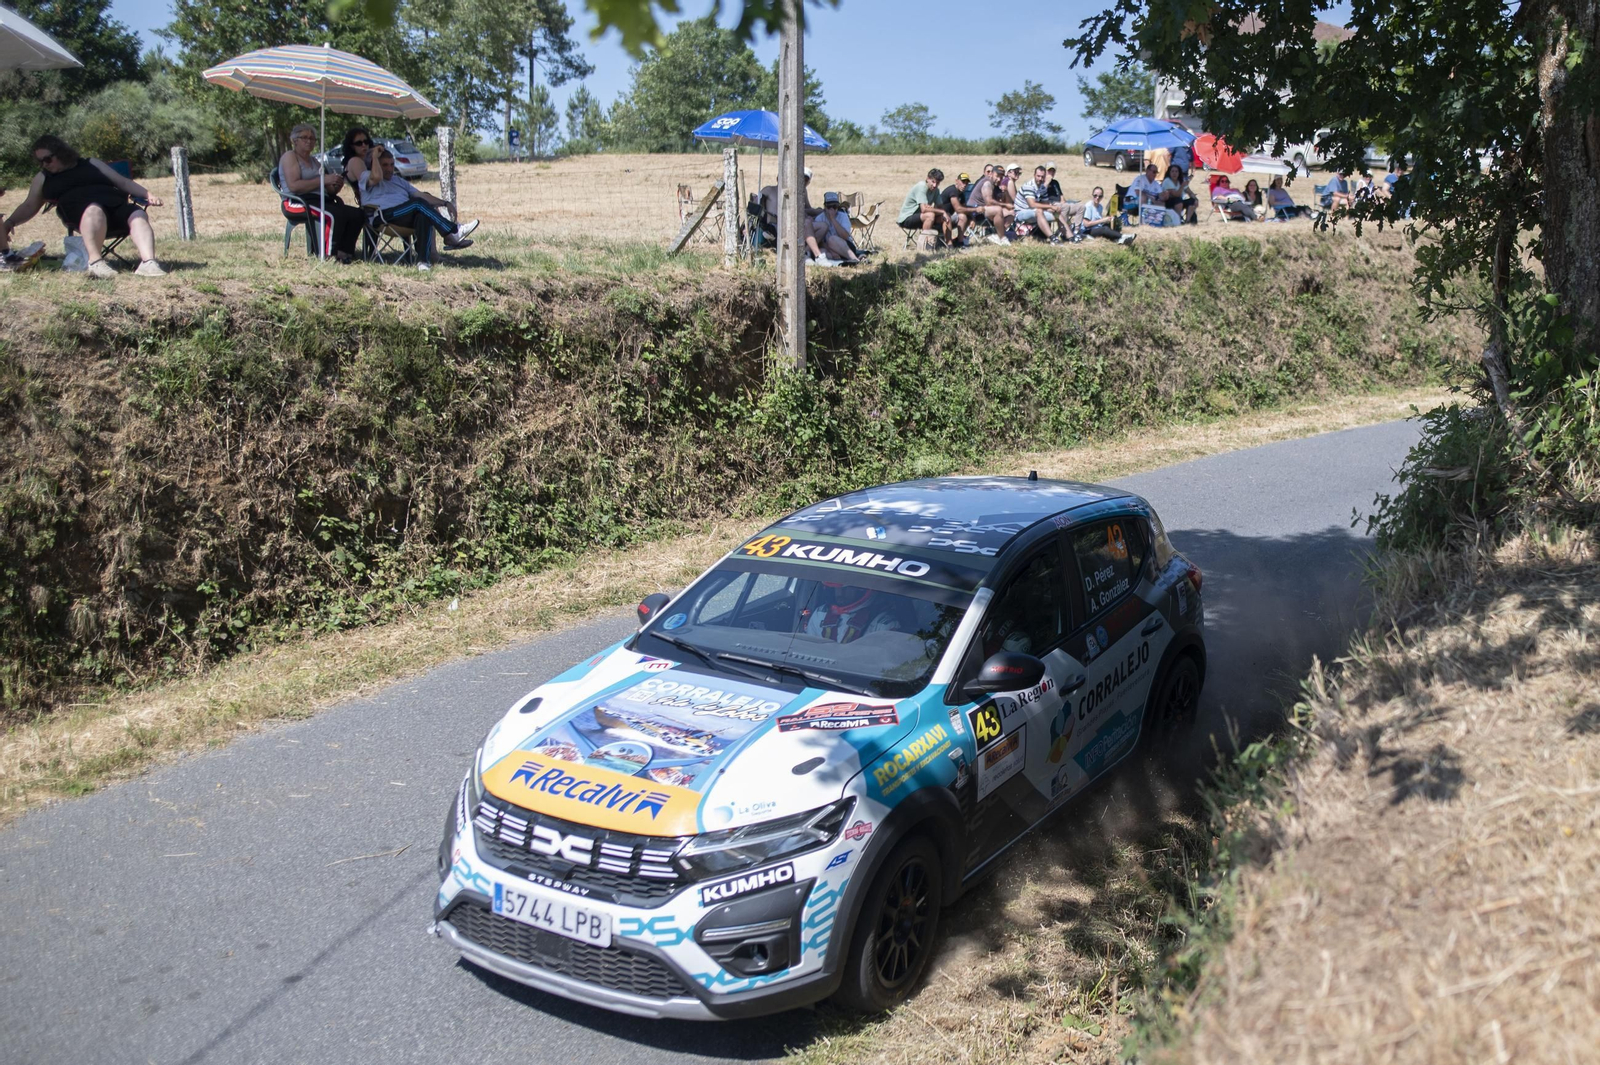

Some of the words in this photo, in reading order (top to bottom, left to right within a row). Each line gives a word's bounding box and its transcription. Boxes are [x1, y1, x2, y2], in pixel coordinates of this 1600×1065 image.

[743, 534, 792, 558] 43
[782, 543, 931, 577] KUMHO
[1084, 577, 1095, 592] D.
[1094, 564, 1115, 587] Pérez
[1091, 598, 1100, 613] A.
[1099, 577, 1130, 607] González
[640, 678, 781, 713] CORRALEJO
[1078, 640, 1149, 721] CORRALEJO
[820, 719, 859, 730] Recalvi
[975, 705, 1001, 742] 43
[1000, 702, 1018, 720] La
[873, 724, 948, 786] ROCARXAVI
[529, 768, 646, 812] Recalvi
[753, 801, 776, 811] Oliva
[528, 873, 589, 896] STEPWAY
[703, 865, 793, 903] KUMHO
[505, 889, 554, 927] 5744
[561, 907, 602, 939] LPB
